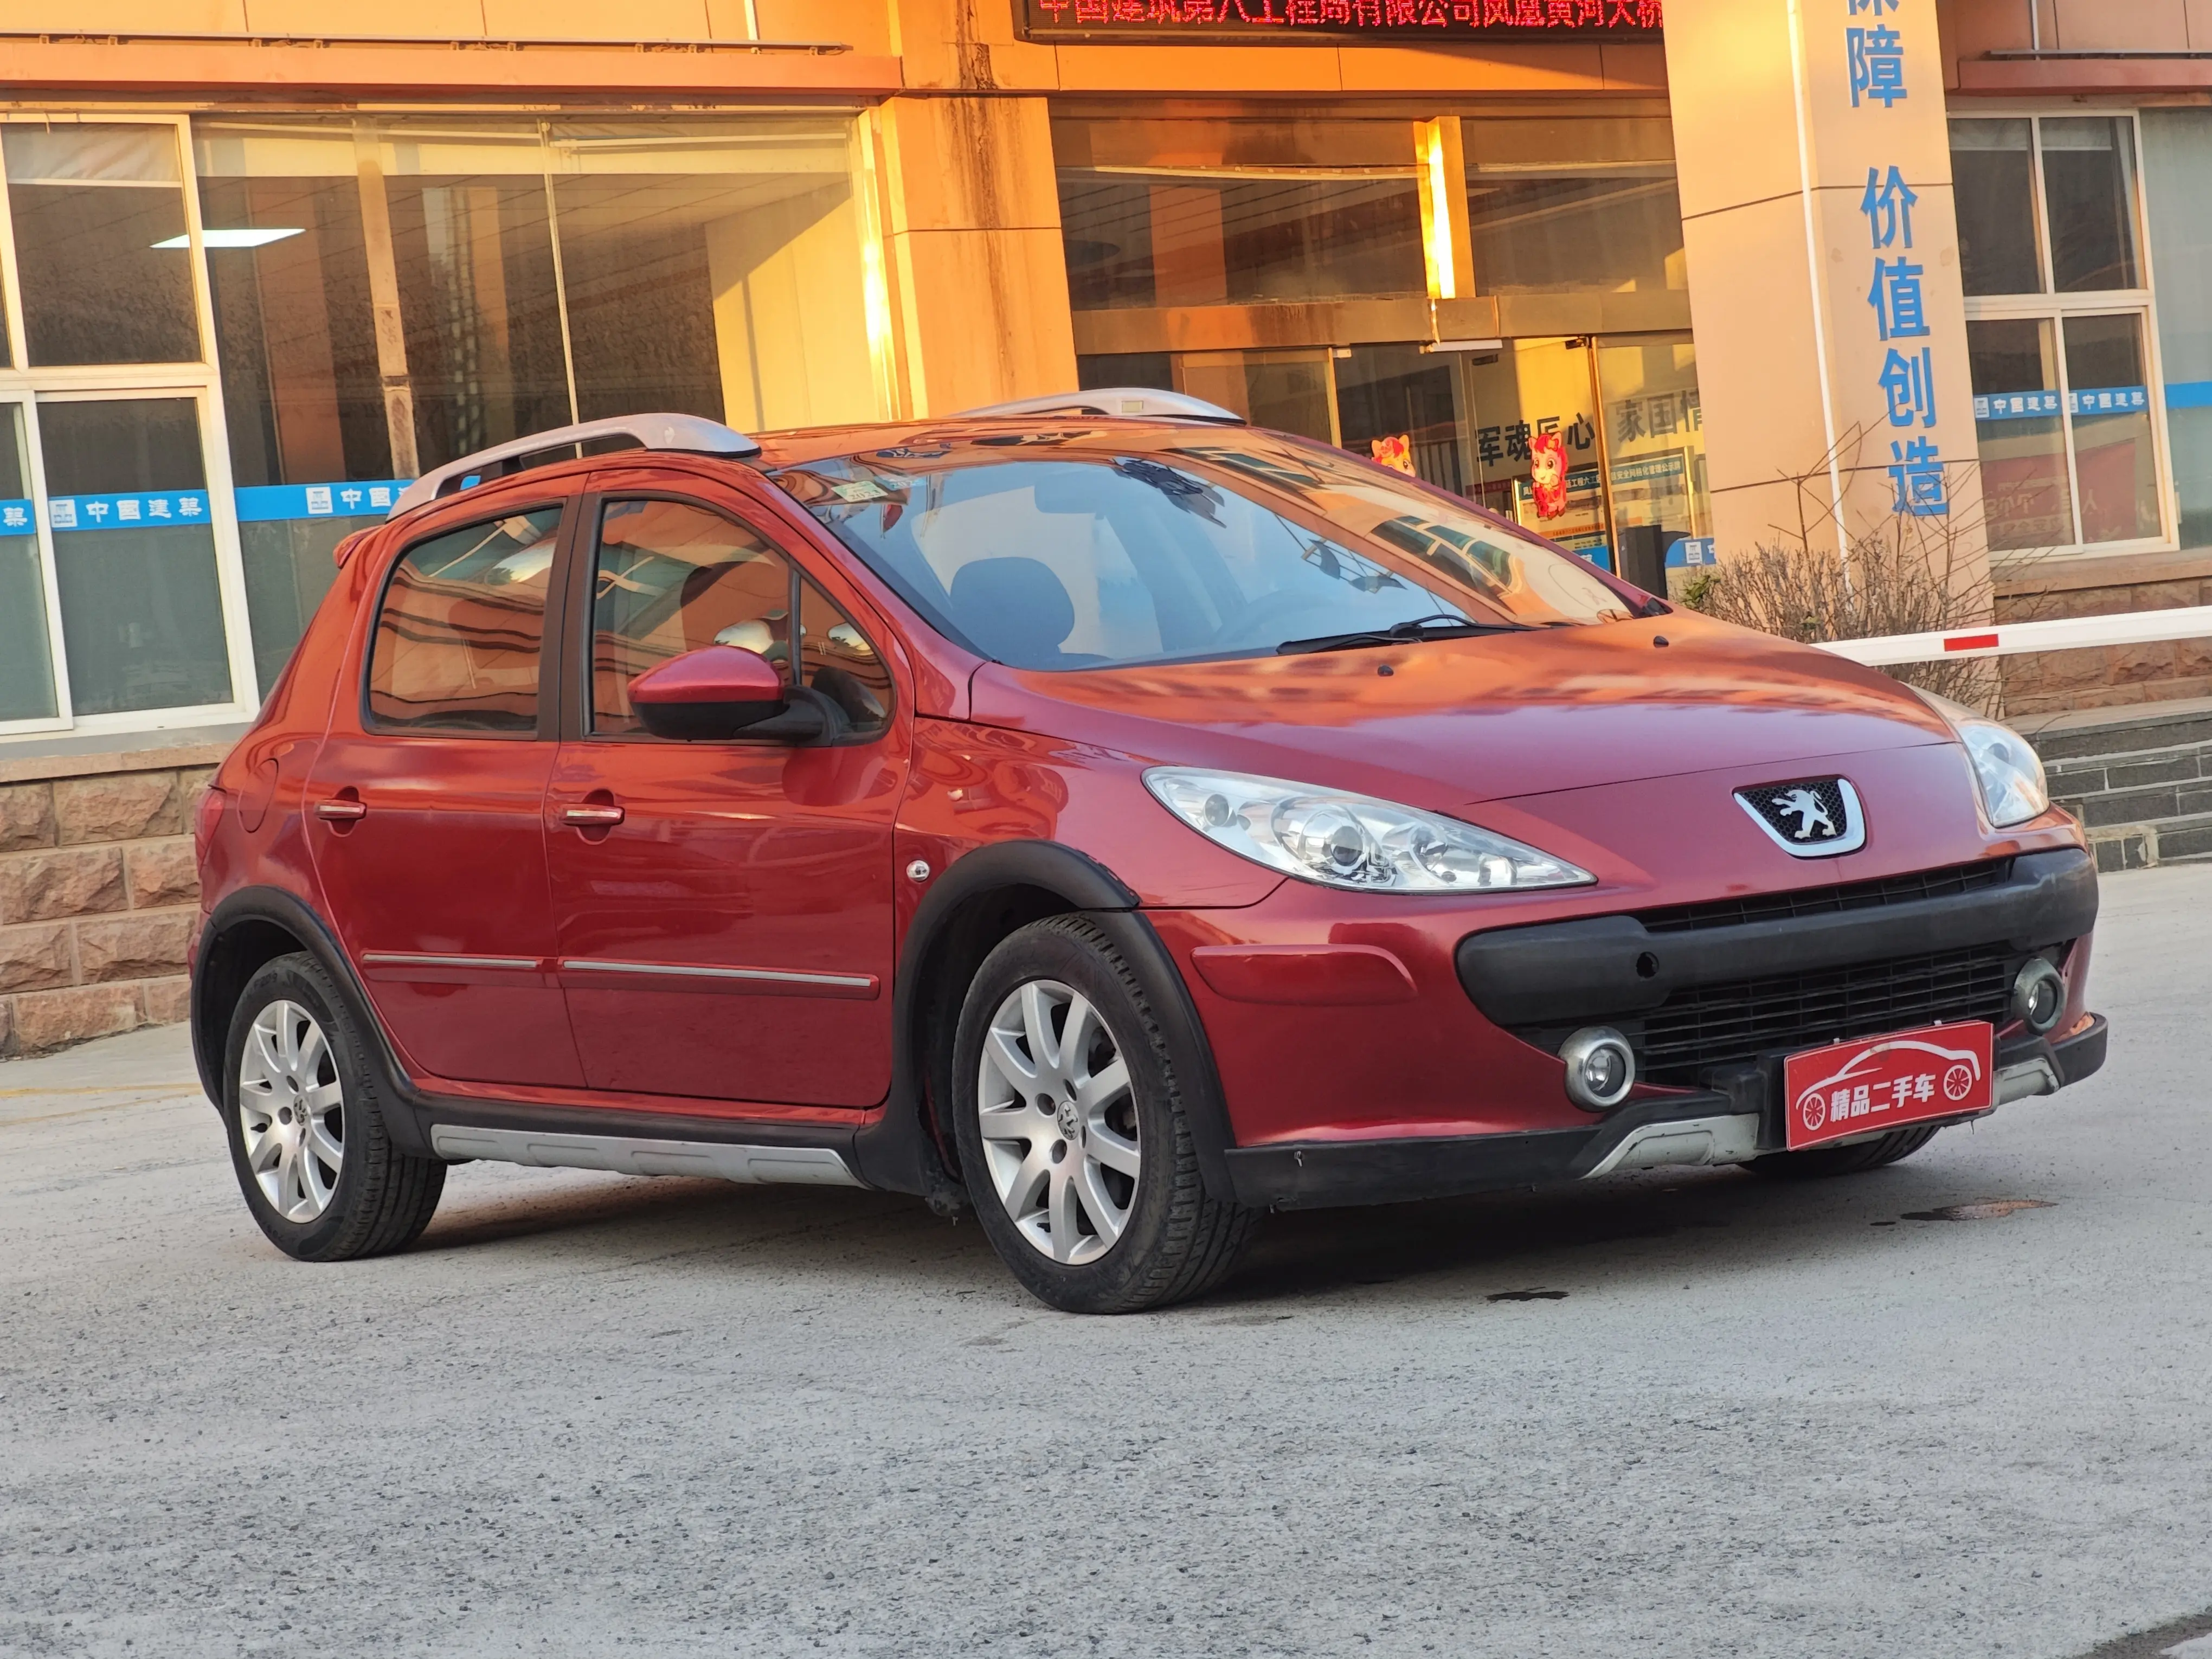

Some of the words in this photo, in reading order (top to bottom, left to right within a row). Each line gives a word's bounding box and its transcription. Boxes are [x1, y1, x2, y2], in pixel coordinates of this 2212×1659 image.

[1844, 0, 1907, 108] 障
[1859, 165, 1950, 517] 价值创造
[340, 486, 410, 510] 中國
[1830, 1073, 1936, 1122] 精品二手车
